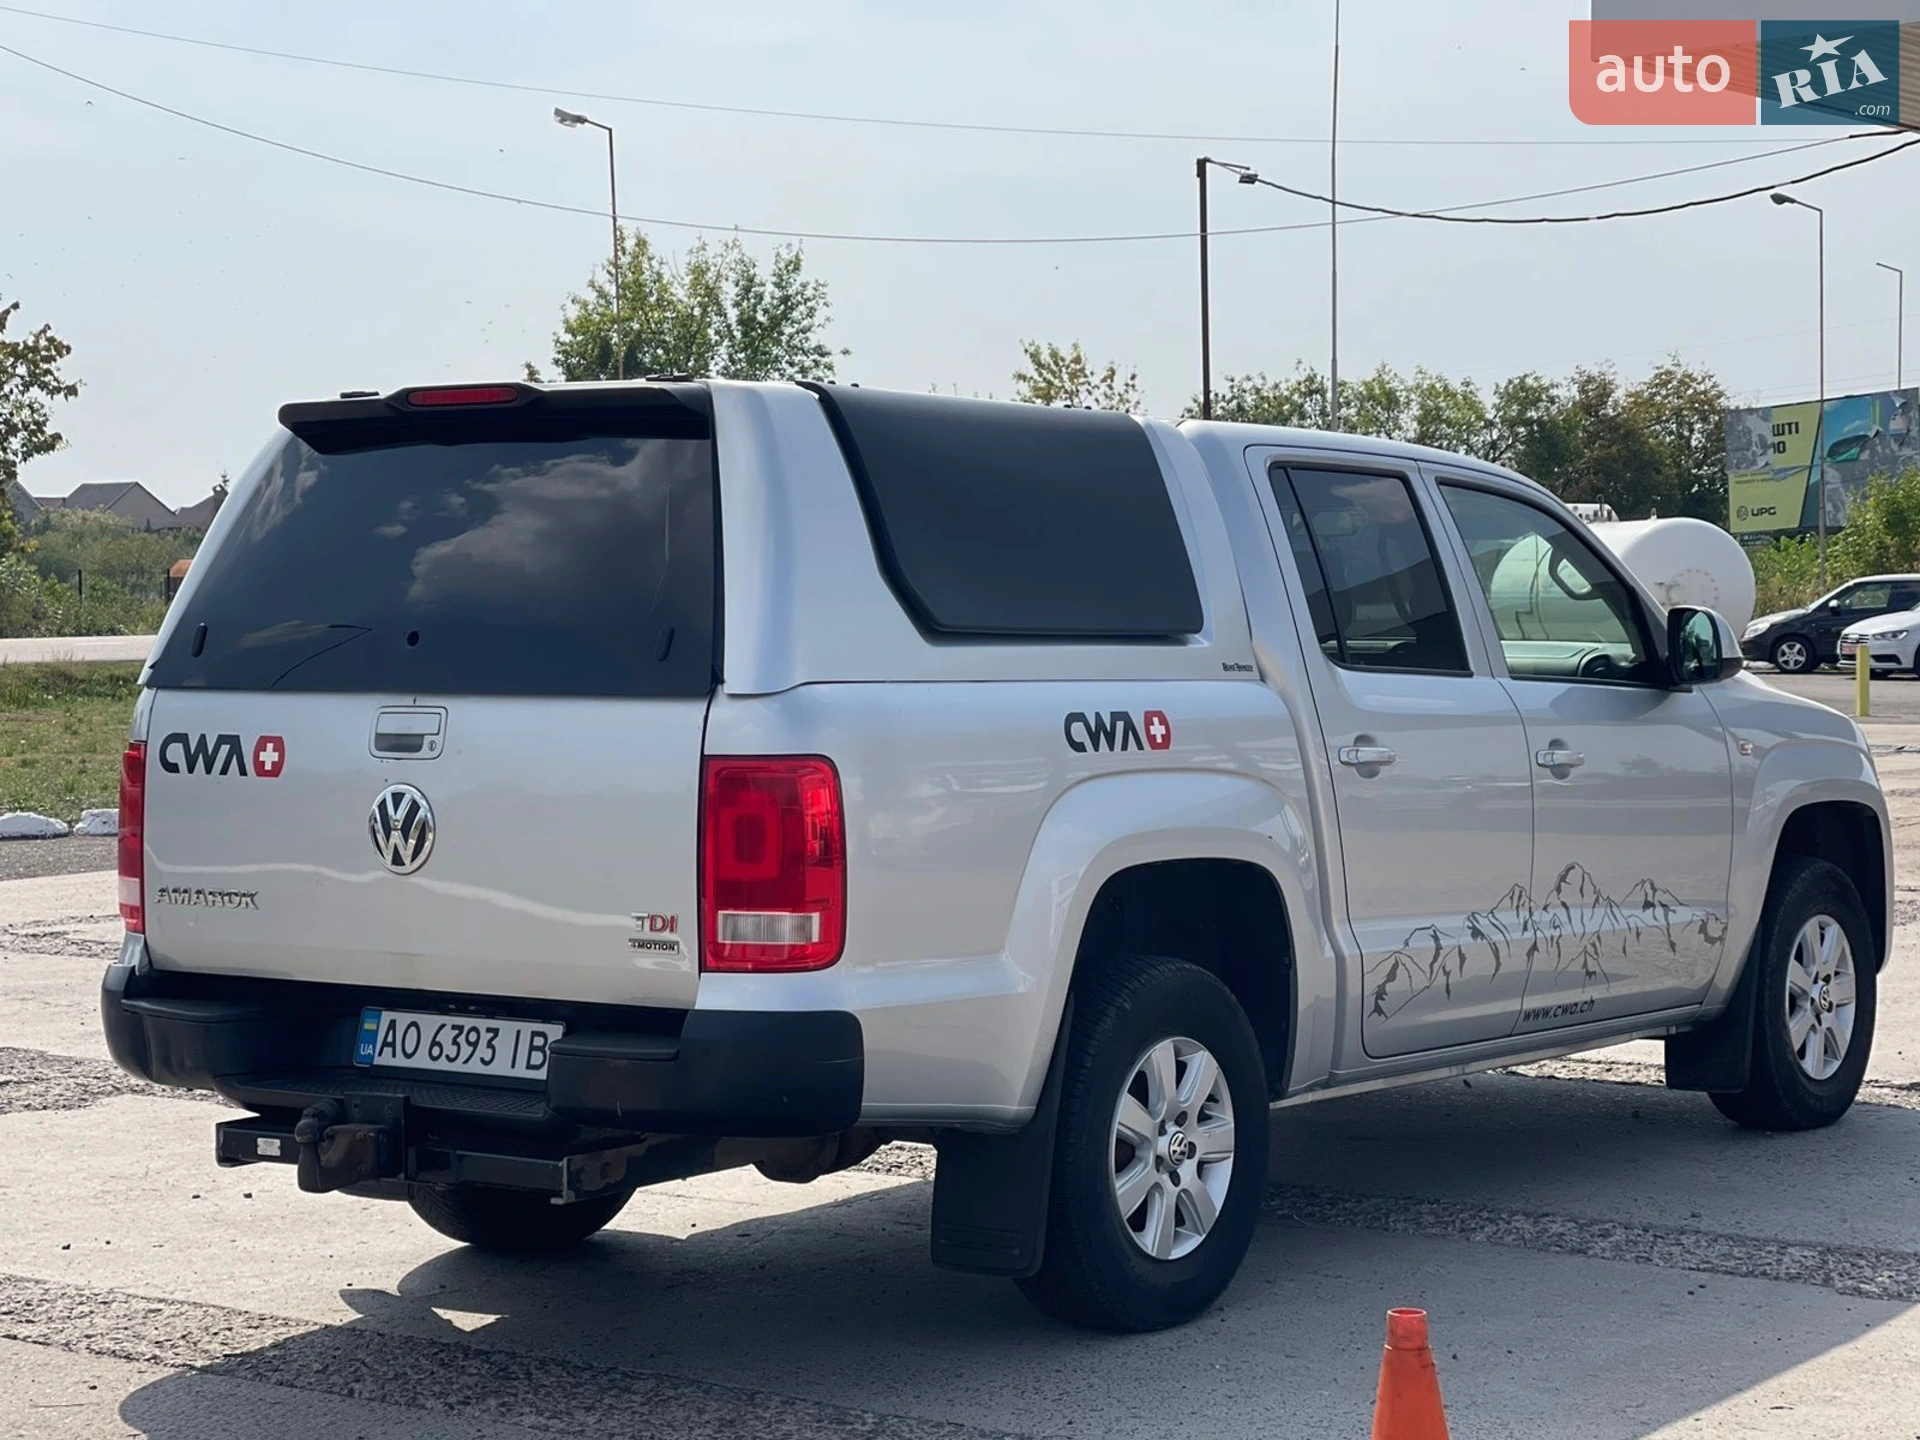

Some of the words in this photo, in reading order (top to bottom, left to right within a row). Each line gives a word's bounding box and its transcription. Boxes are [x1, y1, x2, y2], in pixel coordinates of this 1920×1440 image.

[1750, 506, 1777, 517] UPG
[1064, 711, 1145, 753] CWA
[158, 732, 248, 777] CWA
[155, 885, 260, 910] AMAROK
[630, 911, 678, 933] TDI
[630, 940, 677, 951] 4MOTION
[1523, 995, 1596, 1022] www.cwa.ch
[360, 1043, 374, 1056] UA
[377, 1019, 422, 1059] AO
[428, 1023, 500, 1066] 6393
[510, 1029, 549, 1070] IB
